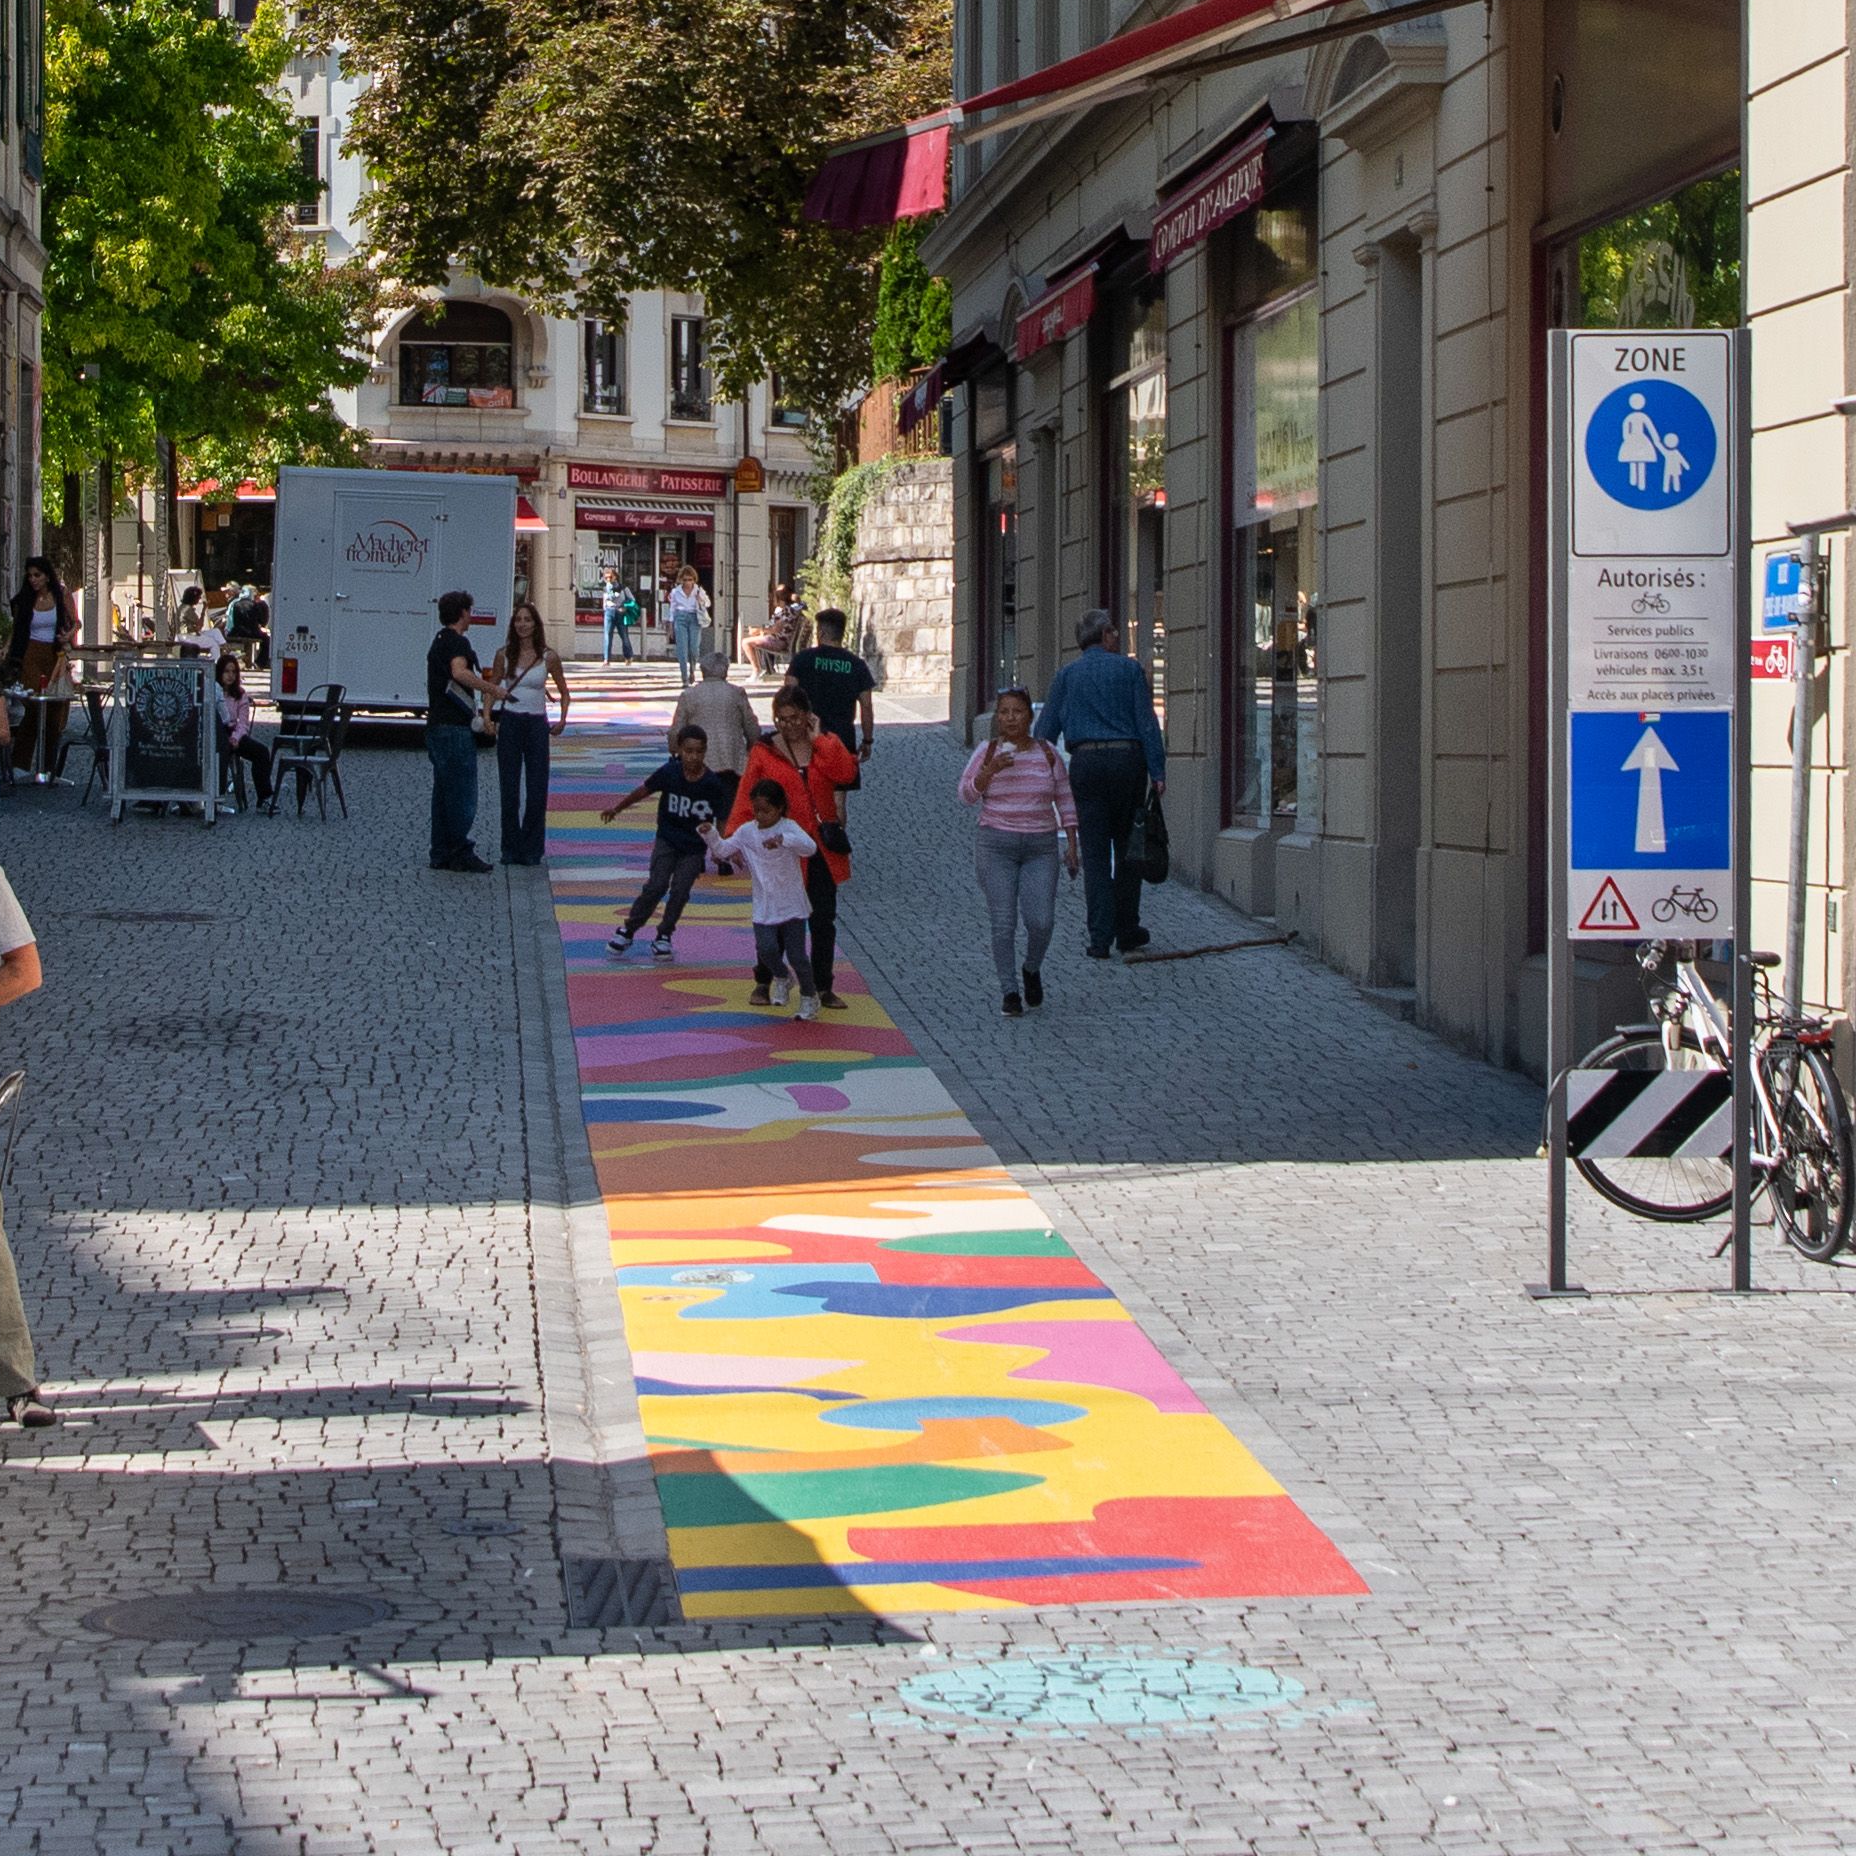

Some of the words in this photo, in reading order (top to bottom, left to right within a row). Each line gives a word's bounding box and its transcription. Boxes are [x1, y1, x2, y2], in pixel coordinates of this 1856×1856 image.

[1614, 347, 1686, 372] ZONE
[570, 467, 649, 489] BOULANGERIE
[660, 474, 723, 493] PATISSERIE
[346, 544, 412, 568] fromage
[597, 549, 619, 565] PAIN
[1597, 567, 1696, 589] Autorisés
[1607, 624, 1652, 637] Services
[1655, 624, 1695, 638] publics
[1593, 648, 1649, 660] Livraisons
[814, 656, 852, 675] PHYSIO
[1596, 664, 1647, 676] véhicules
[1680, 664, 1697, 678] 3,5
[1587, 688, 1617, 701] Accès
[1620, 690, 1639, 701] aux
[1641, 687, 1675, 703] places
[1677, 688, 1716, 703] privées
